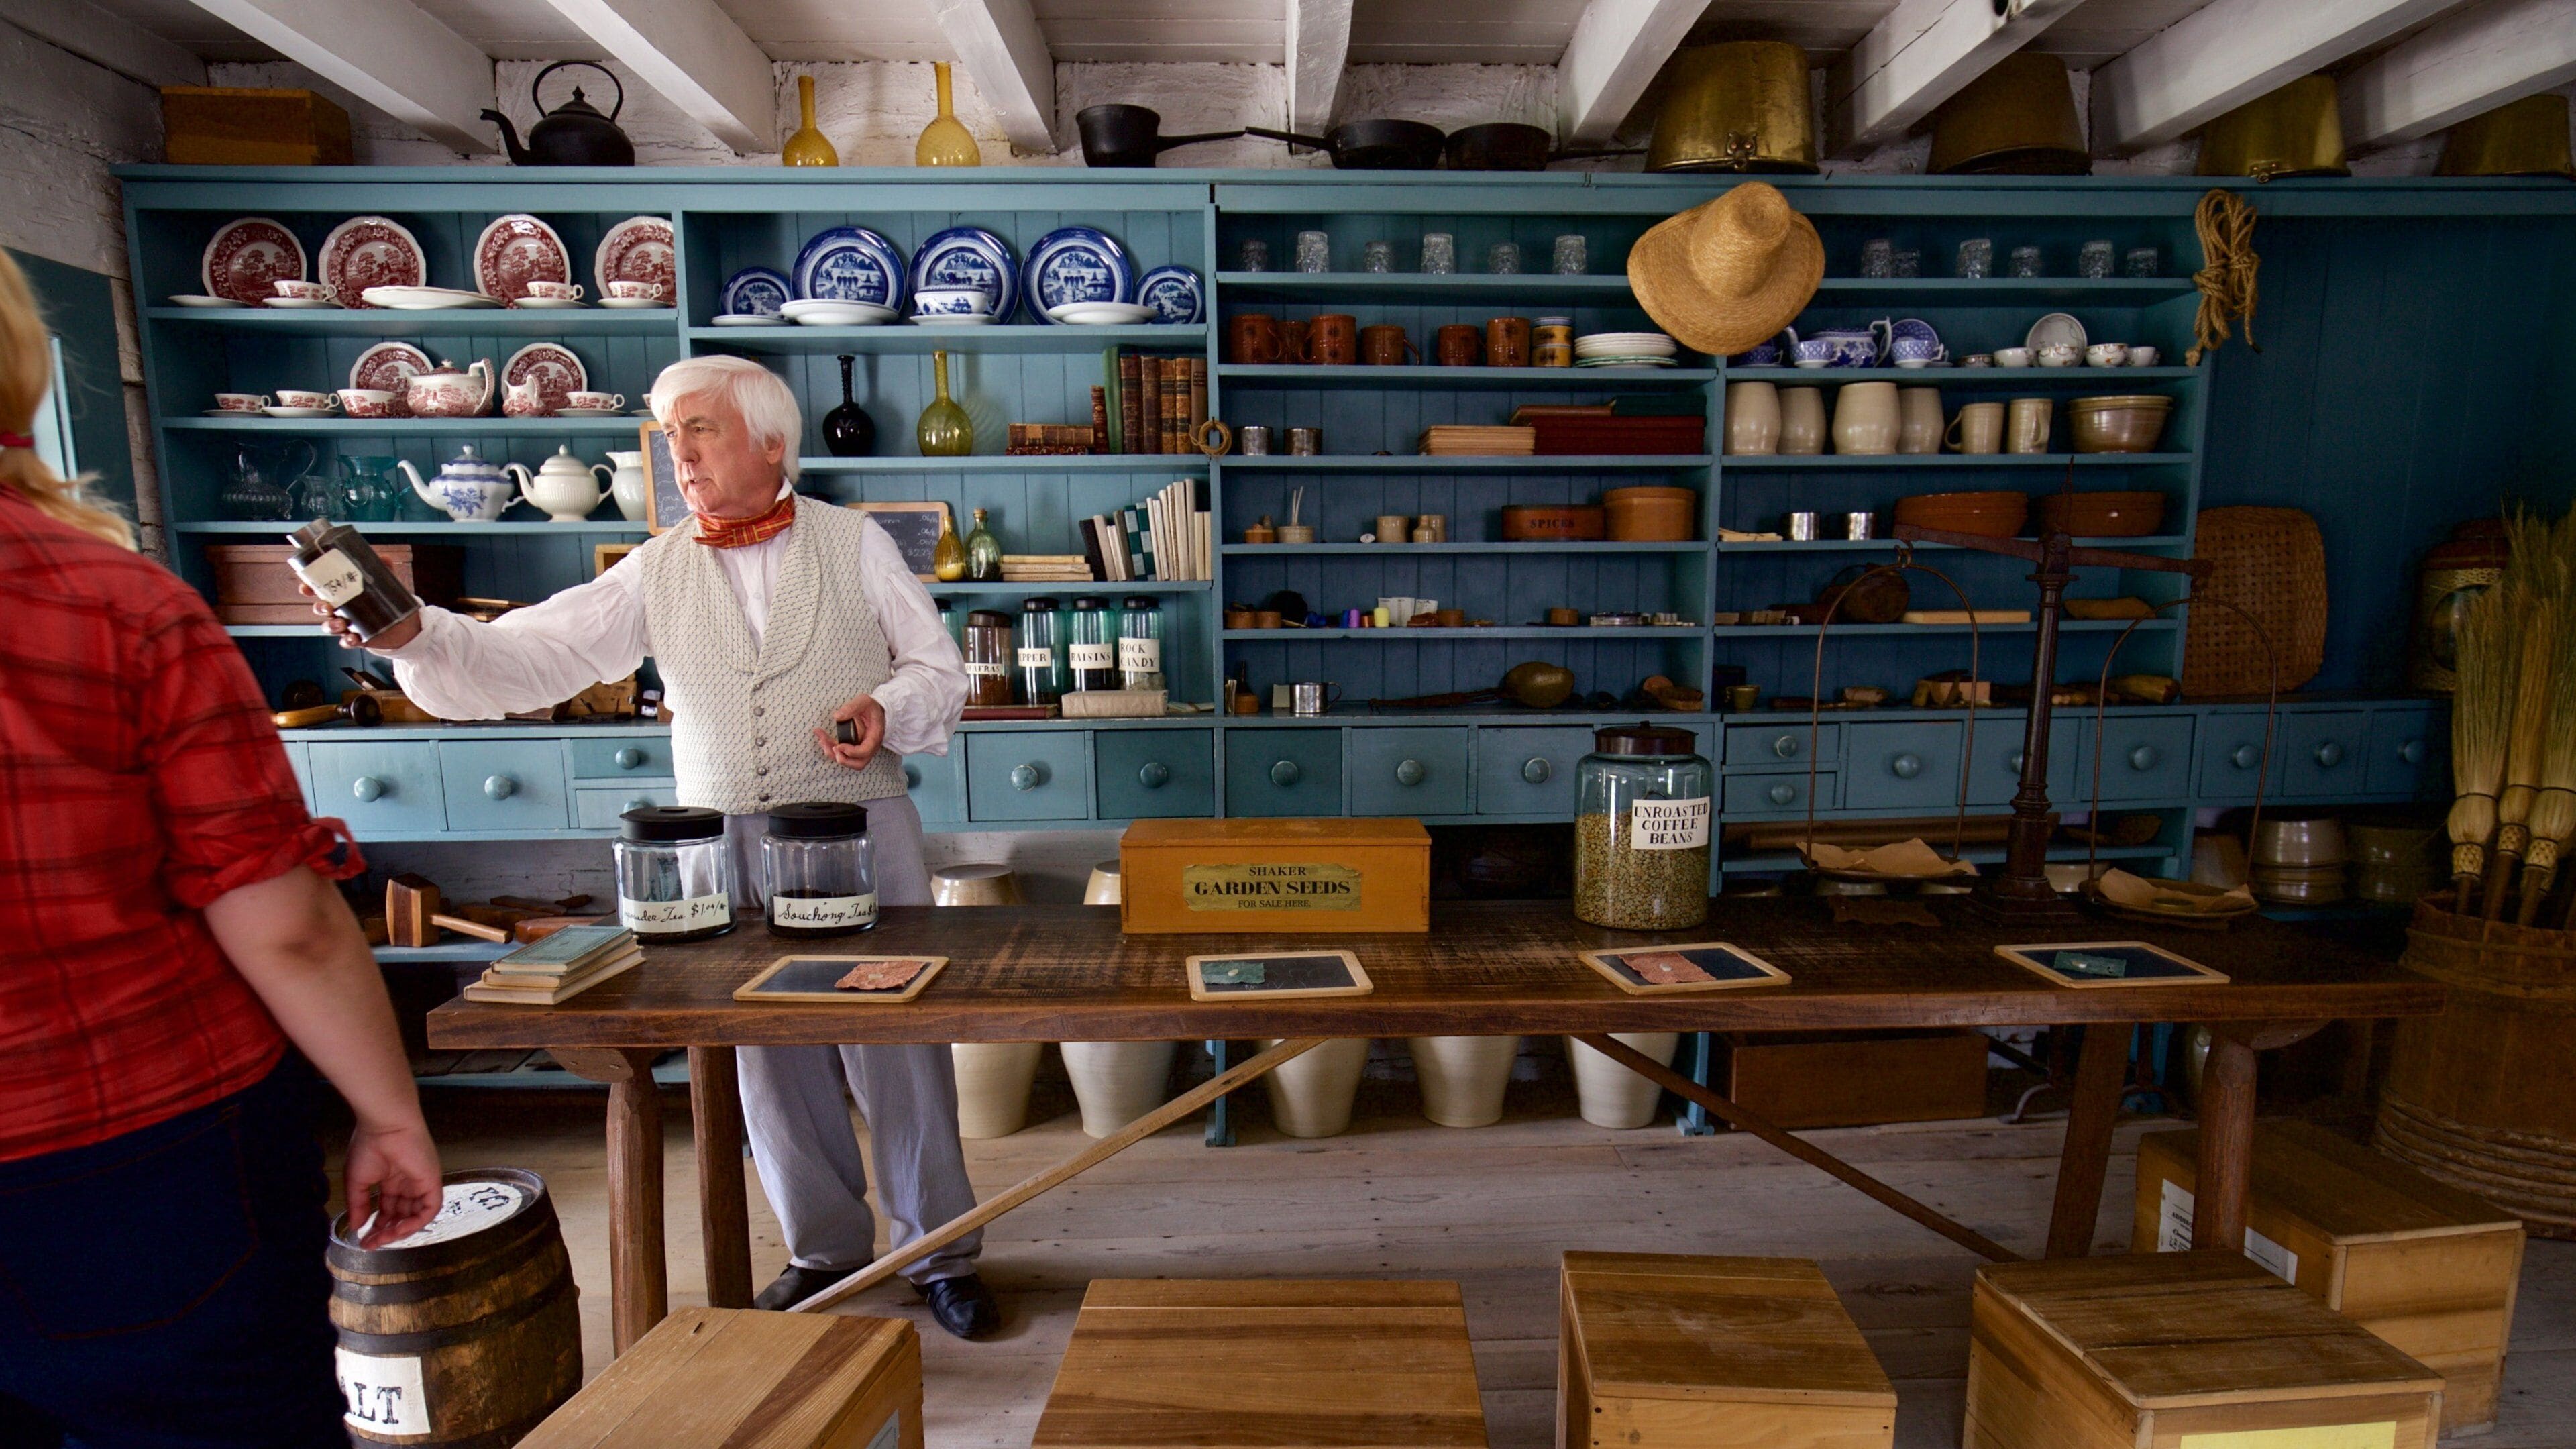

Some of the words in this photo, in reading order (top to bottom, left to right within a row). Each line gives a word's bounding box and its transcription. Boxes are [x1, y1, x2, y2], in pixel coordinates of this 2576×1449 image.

[1529, 519, 1574, 529] SPICES
[1120, 643, 1146, 654] ROCK
[1019, 653, 1046, 662] EPPER
[1071, 652, 1111, 661] RAISINS
[1120, 657, 1158, 667] CANDY
[1634, 802, 1707, 818] UNROASTED
[1642, 817, 1699, 832] COFFEE
[1649, 831, 1693, 845] BEANS
[1249, 866, 1307, 876] SHAKER
[1195, 881, 1281, 895] GARDEN
[1286, 881, 1350, 894] SEEDS
[1238, 900, 1257, 908] FOR
[1259, 900, 1282, 908] SALE
[660, 906, 686, 922] Tea
[778, 901, 846, 924] Souchong
[847, 902, 867, 918] Tea
